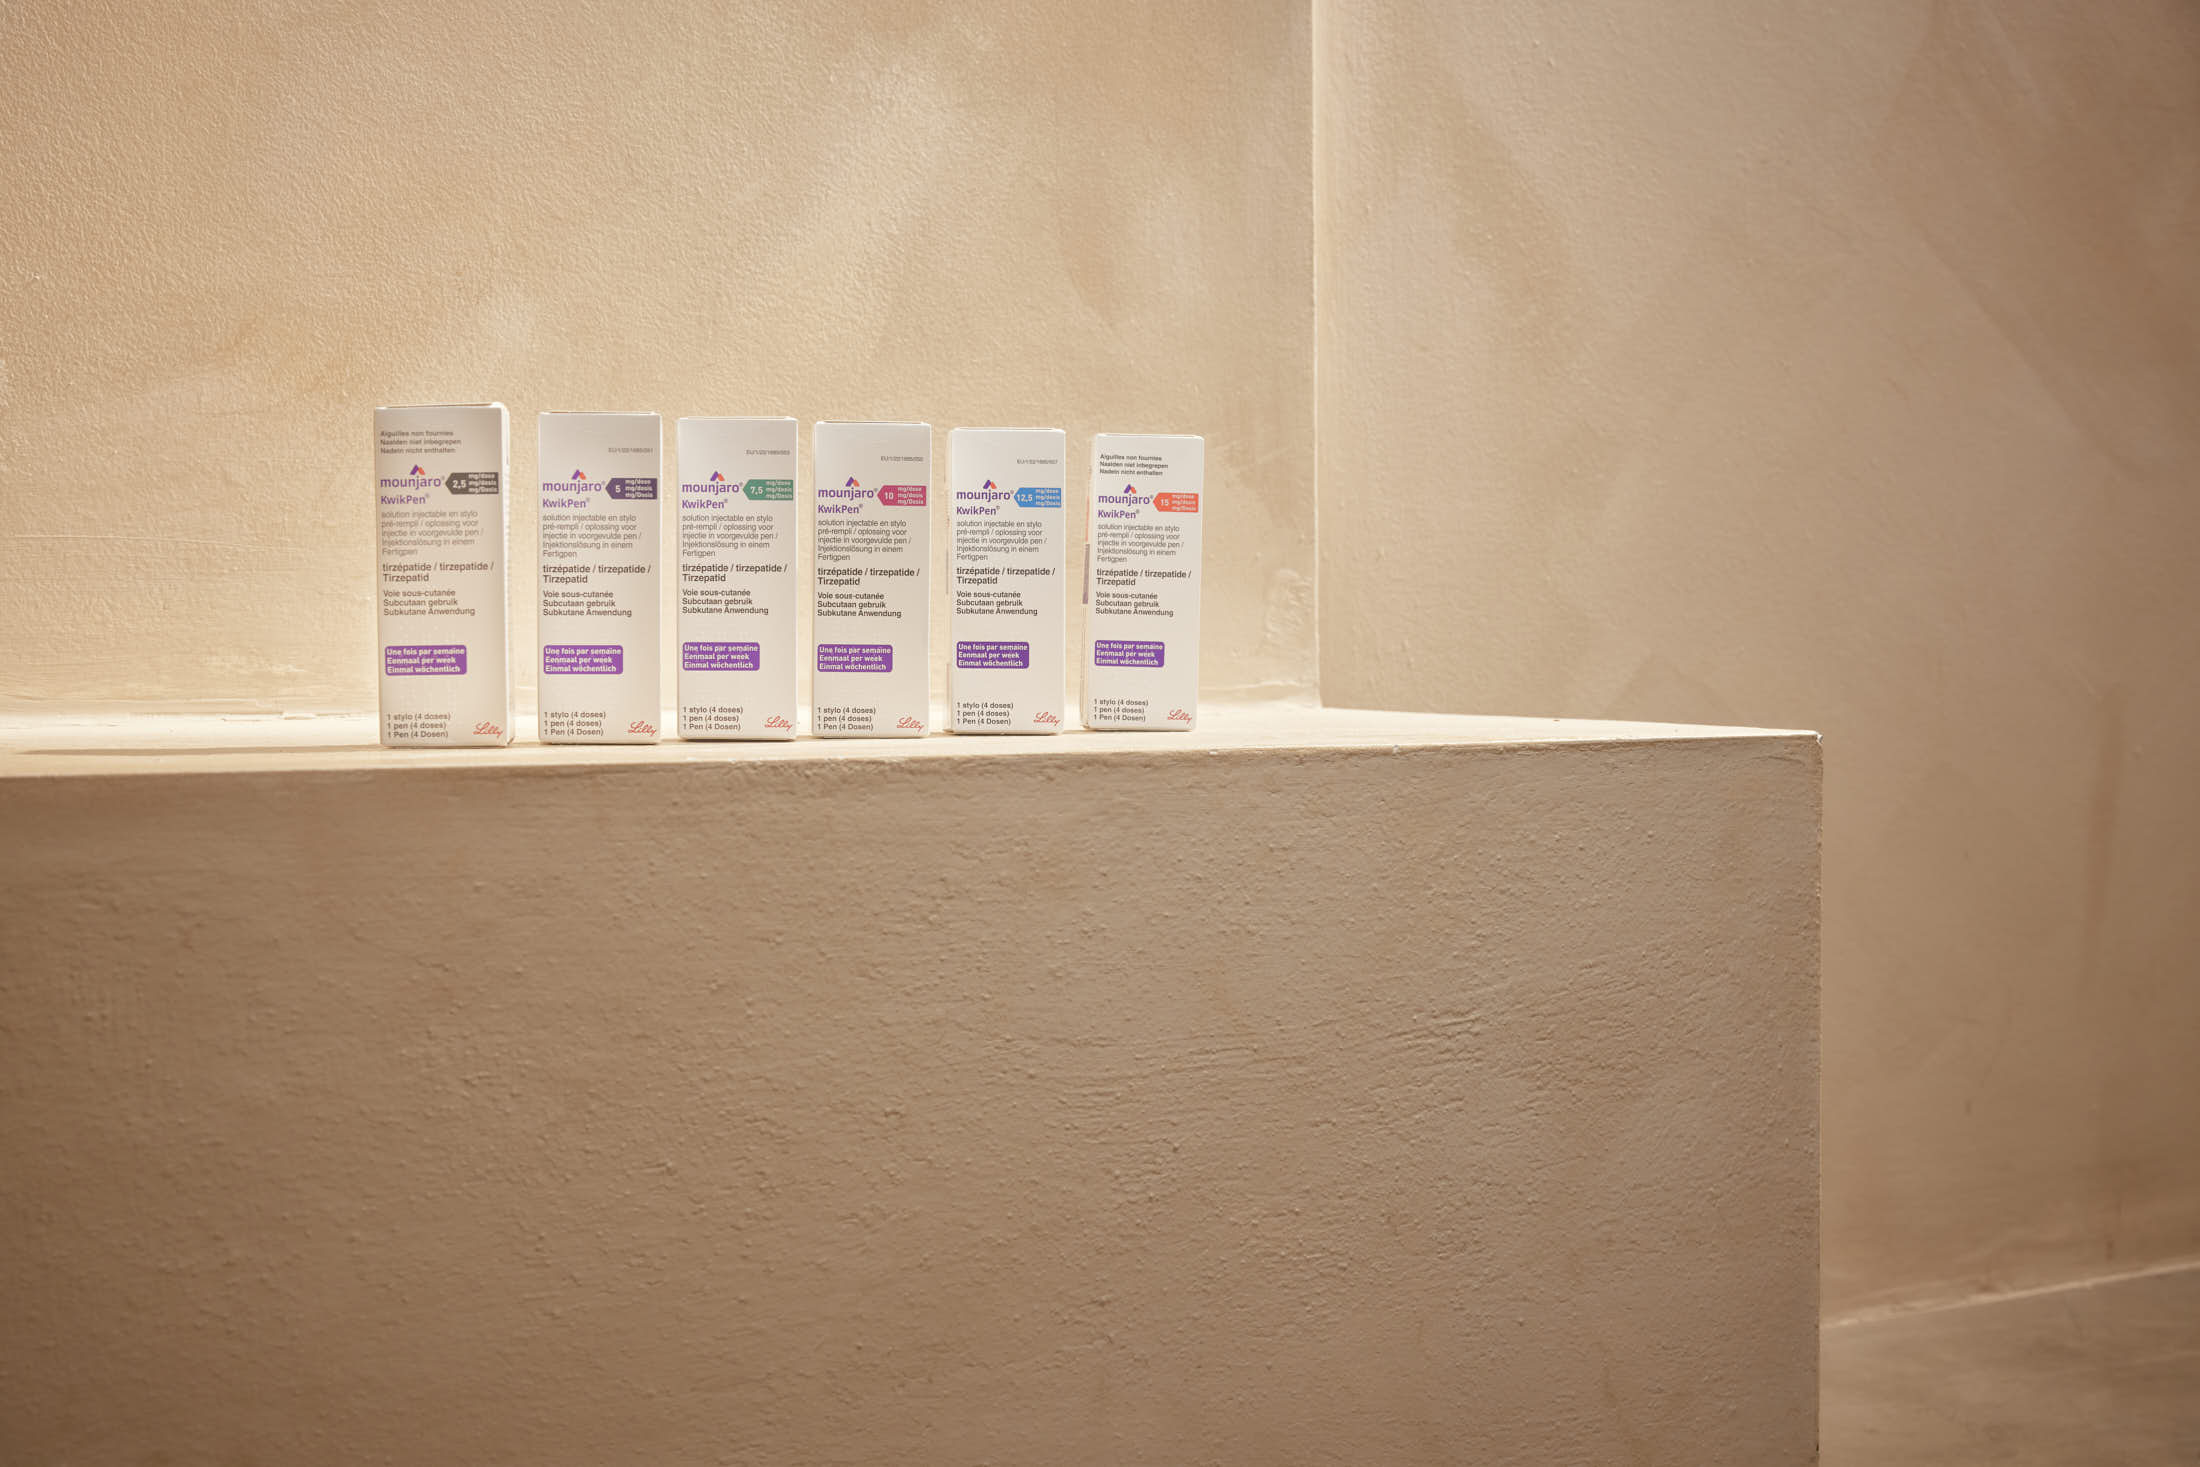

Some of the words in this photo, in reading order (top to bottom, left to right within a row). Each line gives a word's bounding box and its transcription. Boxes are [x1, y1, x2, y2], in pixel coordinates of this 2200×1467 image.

[453, 480, 466, 488] 2,5
[751, 486, 763, 495] 7,5
[1017, 494, 1032, 502] 12,5
[984, 520, 1014, 528] injectable
[818, 554, 850, 562] Fertigpen
[383, 563, 431, 572] tirzépatide
[440, 562, 488, 572] tirzepatide
[543, 565, 590, 574] tirzépatide
[598, 565, 645, 574] tirzepatide
[683, 564, 728, 573] tirzépatide
[736, 564, 782, 573] tirzepatide
[957, 567, 1000, 576] tirzépatide
[1007, 567, 1050, 576] tirzepatide
[818, 568, 862, 577] tirzépatide
[870, 568, 916, 577] tirzepatide
[1097, 568, 1138, 577] tirzépatide
[1145, 569, 1186, 579] tirzepatide
[384, 574, 429, 583] Tirzepatid
[544, 575, 588, 584] Tirzepatid
[683, 574, 726, 583] Tirzepatid
[818, 577, 860, 586] Tirzepatid
[957, 577, 997, 585] Tirzepatid
[1097, 578, 1136, 586] Tirzepatid
[384, 599, 426, 607] Subcutaan
[428, 599, 458, 607] gebruik
[587, 600, 615, 608] gebruik
[724, 598, 752, 606] gebruik
[859, 601, 886, 609] gebruik
[996, 600, 1023, 608] gebruik
[1134, 601, 1159, 609] gebruik
[384, 608, 426, 616] Subkutane
[428, 608, 475, 616] Anwendung
[586, 609, 632, 617] Anwendung
[724, 607, 768, 615] Anwendung
[858, 610, 901, 618] Anwendung
[996, 608, 1037, 616] Anwendung
[1133, 609, 1173, 617] Anwendung
[387, 657, 419, 665] Eenmaal
[422, 658, 434, 666] per
[689, 706, 707, 715] stylo
[709, 706, 716, 715] (4
[718, 706, 743, 714] doses)
[1034, 712, 1061, 726] Lilly
[1168, 709, 1192, 723] Lilly
[765, 716, 792, 731] Lilly
[897, 717, 924, 732] Lilly
[473, 722, 503, 738] Lilly
[628, 721, 656, 736] Lilly
